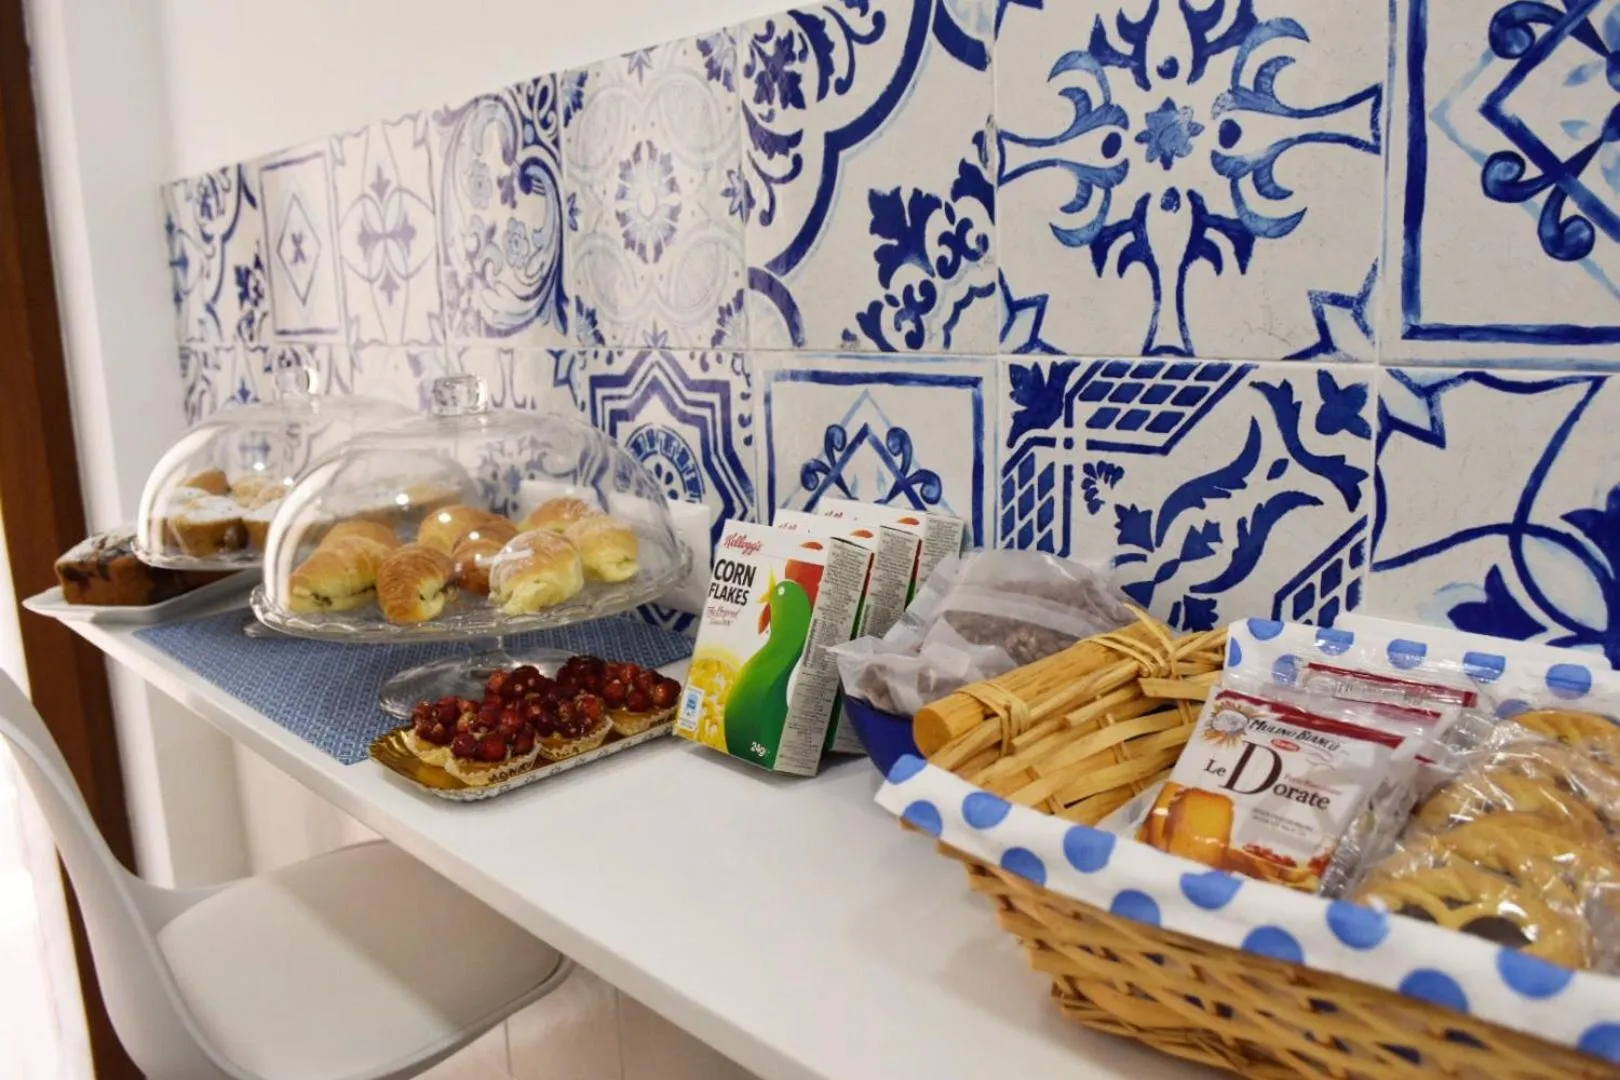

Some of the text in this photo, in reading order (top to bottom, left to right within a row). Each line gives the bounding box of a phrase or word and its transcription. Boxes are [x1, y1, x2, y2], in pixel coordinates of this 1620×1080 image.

[723, 532, 763, 555] Kellogg's
[714, 558, 757, 588] CORN
[708, 582, 750, 607] FLAKES
[1204, 758, 1227, 777] Le
[1218, 740, 1331, 810] Dorate
